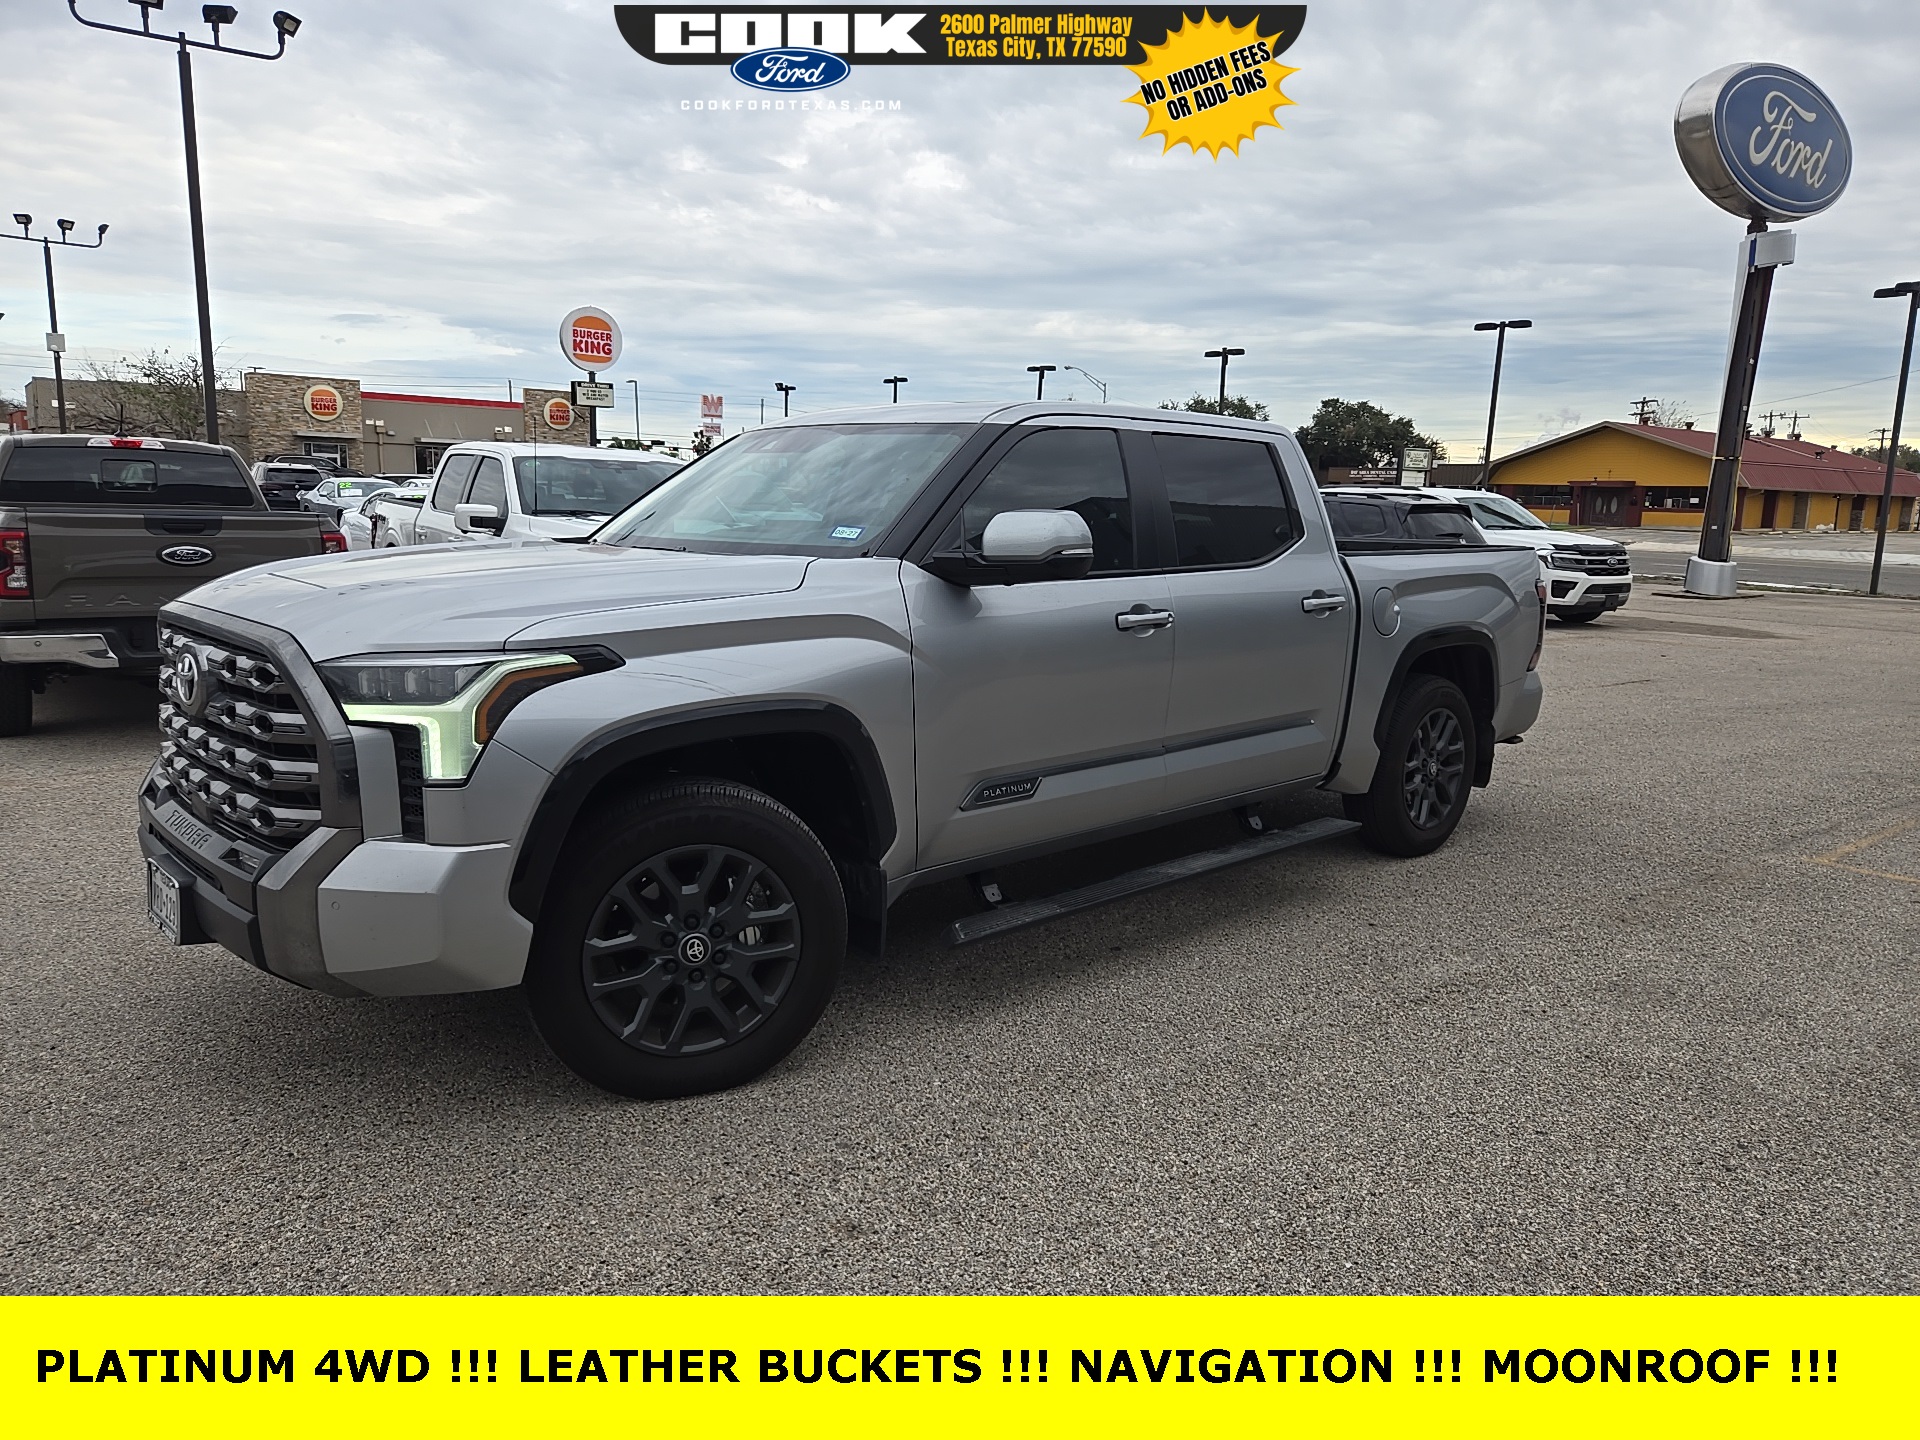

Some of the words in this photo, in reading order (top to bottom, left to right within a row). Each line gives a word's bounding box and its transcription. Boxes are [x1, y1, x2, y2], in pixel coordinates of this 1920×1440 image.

[1748, 90, 1834, 190] Ford
[572, 328, 613, 343] BURGER
[572, 339, 613, 356] KING
[310, 396, 337, 404] BURGER
[311, 402, 338, 412] KING
[550, 413, 571, 422] KING
[983, 782, 1032, 798] PLATINUM
[164, 809, 213, 850] TUNDRA
